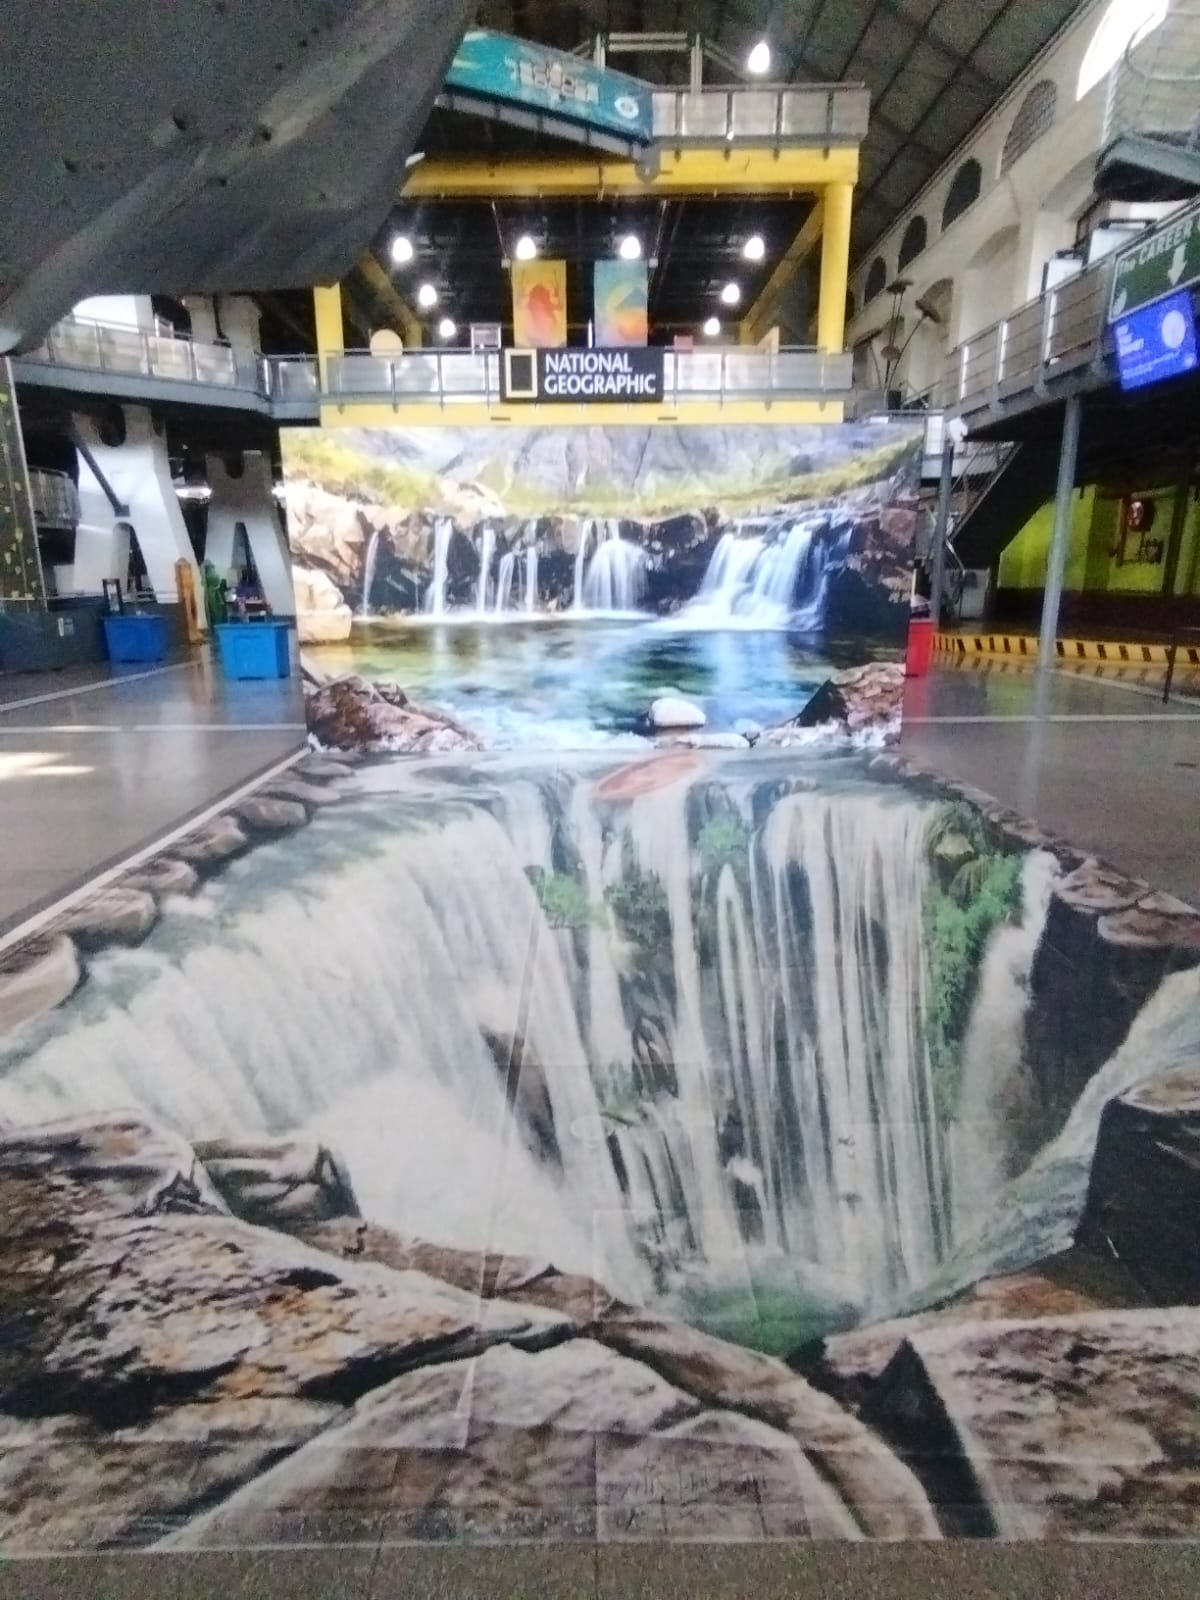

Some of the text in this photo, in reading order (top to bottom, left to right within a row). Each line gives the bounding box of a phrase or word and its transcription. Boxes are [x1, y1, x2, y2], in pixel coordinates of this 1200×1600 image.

[1138, 218, 1193, 265] CAREER
[545, 353, 632, 373] NATIONAL
[544, 373, 656, 394] GEOGRAPHIC
